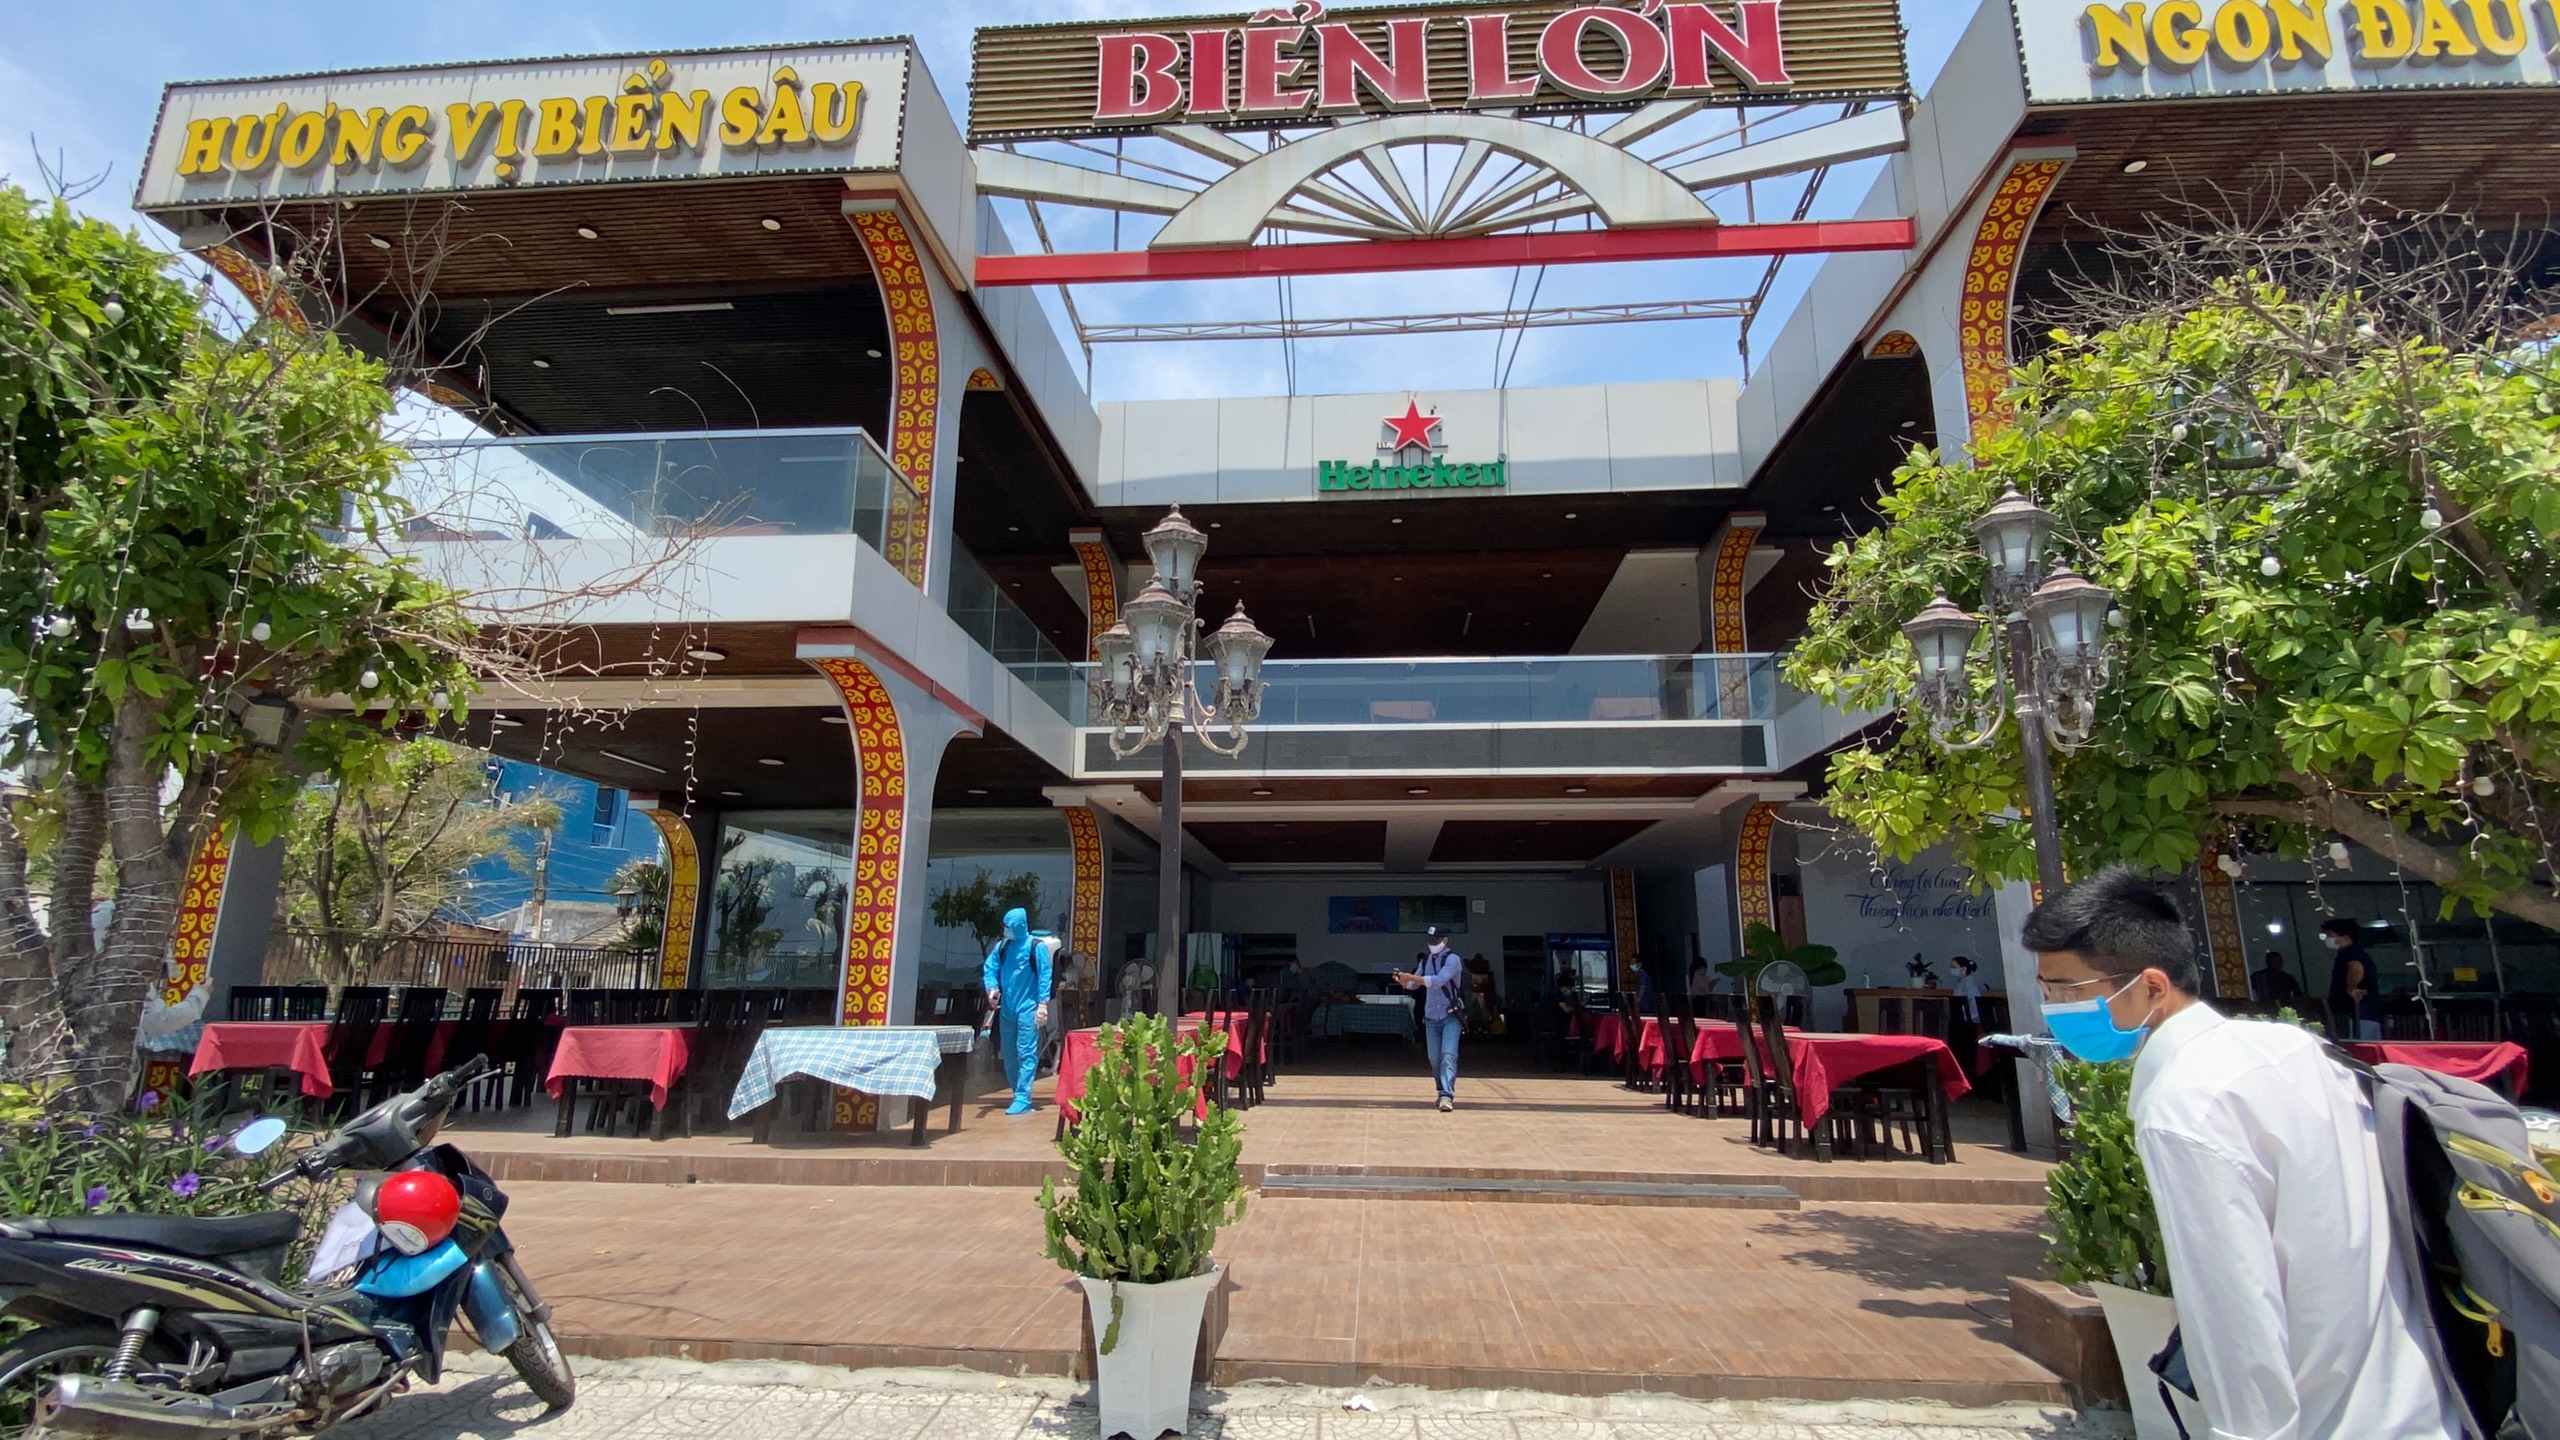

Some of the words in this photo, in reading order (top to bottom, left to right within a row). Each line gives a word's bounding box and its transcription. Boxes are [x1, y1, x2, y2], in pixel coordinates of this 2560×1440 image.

[1092, 0, 1433, 120] BIỂN
[2086, 0, 2332, 68] NGON
[176, 101, 430, 176] HƯƠNG
[444, 99, 527, 177] VỊ
[531, 58, 710, 157] BIỂN
[717, 66, 863, 151] SÂU
[1318, 456, 1507, 492] Heineken
